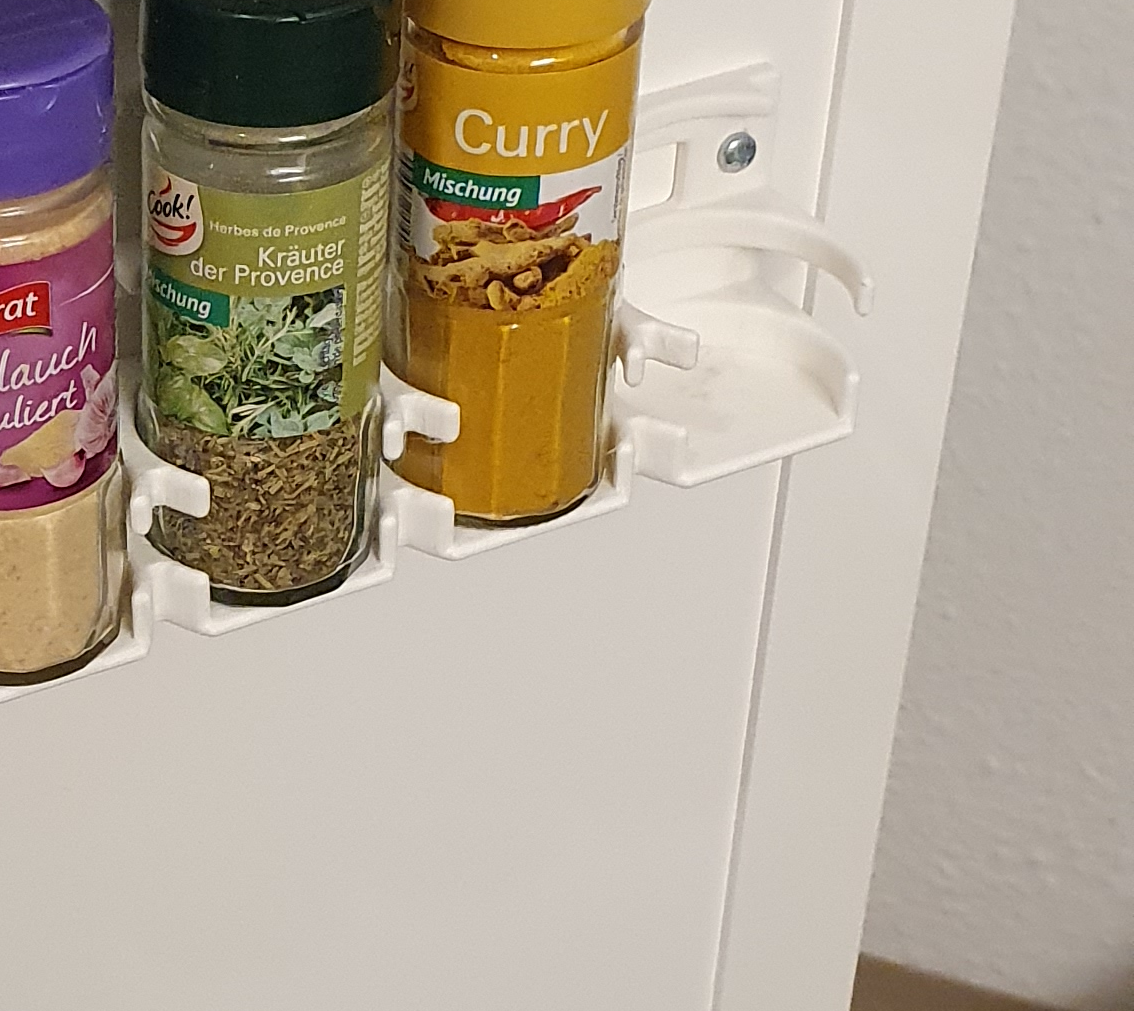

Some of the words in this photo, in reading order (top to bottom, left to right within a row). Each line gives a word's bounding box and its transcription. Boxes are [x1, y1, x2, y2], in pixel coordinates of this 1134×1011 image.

[454, 108, 610, 158] Curry
[423, 167, 522, 208] Mischung
[147, 189, 195, 221] Cook!
[209, 220, 260, 238] Herbes
[262, 225, 281, 238] de
[284, 215, 347, 237] Provence
[258, 239, 346, 269] Kräuter
[189, 256, 227, 282] der
[234, 258, 345, 287] Provence
